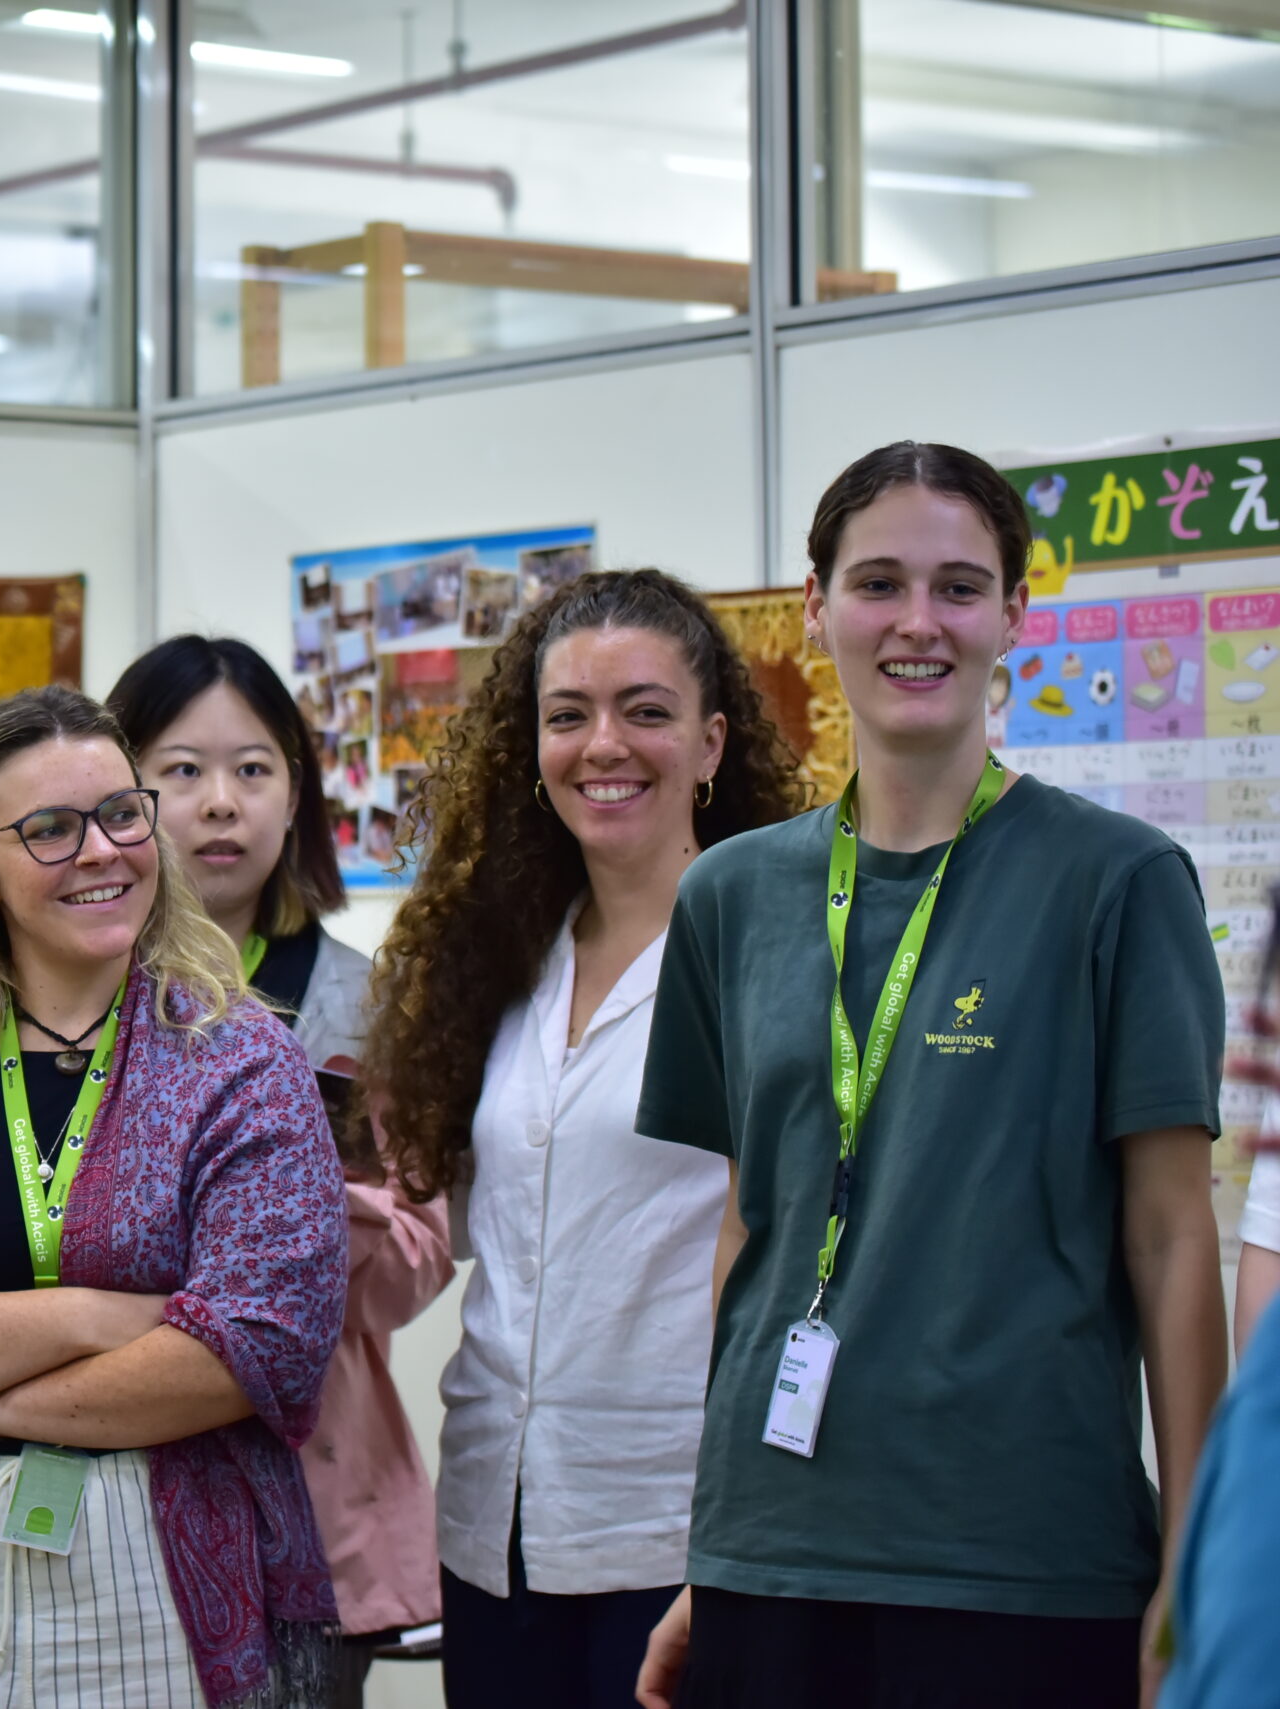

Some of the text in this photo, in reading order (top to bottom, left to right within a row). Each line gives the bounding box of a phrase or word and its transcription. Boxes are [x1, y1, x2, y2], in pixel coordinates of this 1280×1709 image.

[1089, 456, 1280, 546] かぞえ
[839, 1029, 854, 1063] with
[857, 952, 915, 1117] Get global with Acicis
[925, 1033, 995, 1049] WOODSTOCK
[840, 1067, 855, 1112] Acicis
[14, 1118, 48, 1263] Get global with Acicis
[784, 1355, 808, 1369] Danielle
